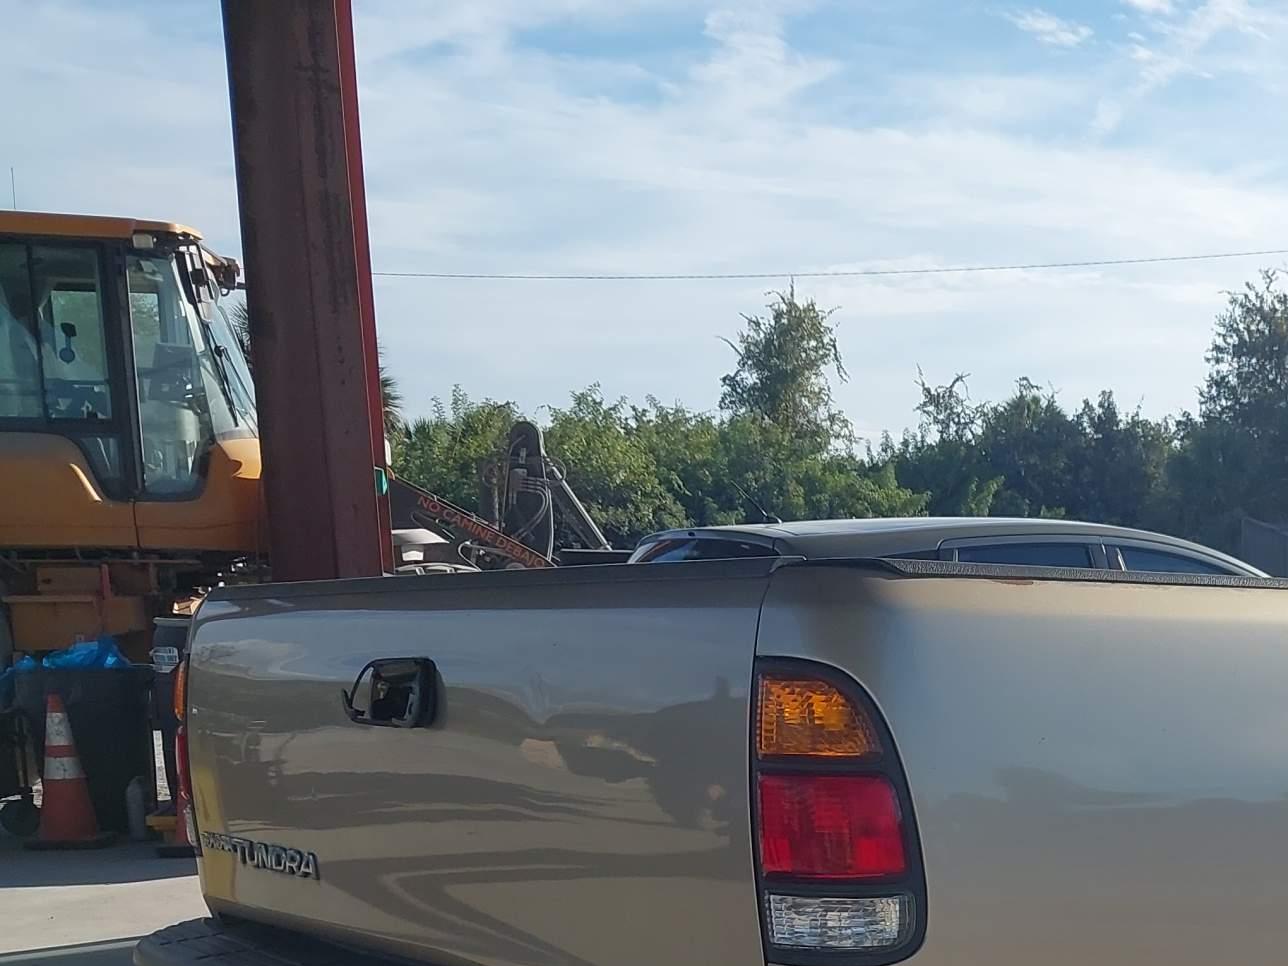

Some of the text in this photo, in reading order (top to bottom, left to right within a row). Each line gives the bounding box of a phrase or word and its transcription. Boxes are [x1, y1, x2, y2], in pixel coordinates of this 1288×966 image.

[417, 496, 546, 569] NO CAMINE DEBAJO
[232, 838, 319, 881] TUNDRA
